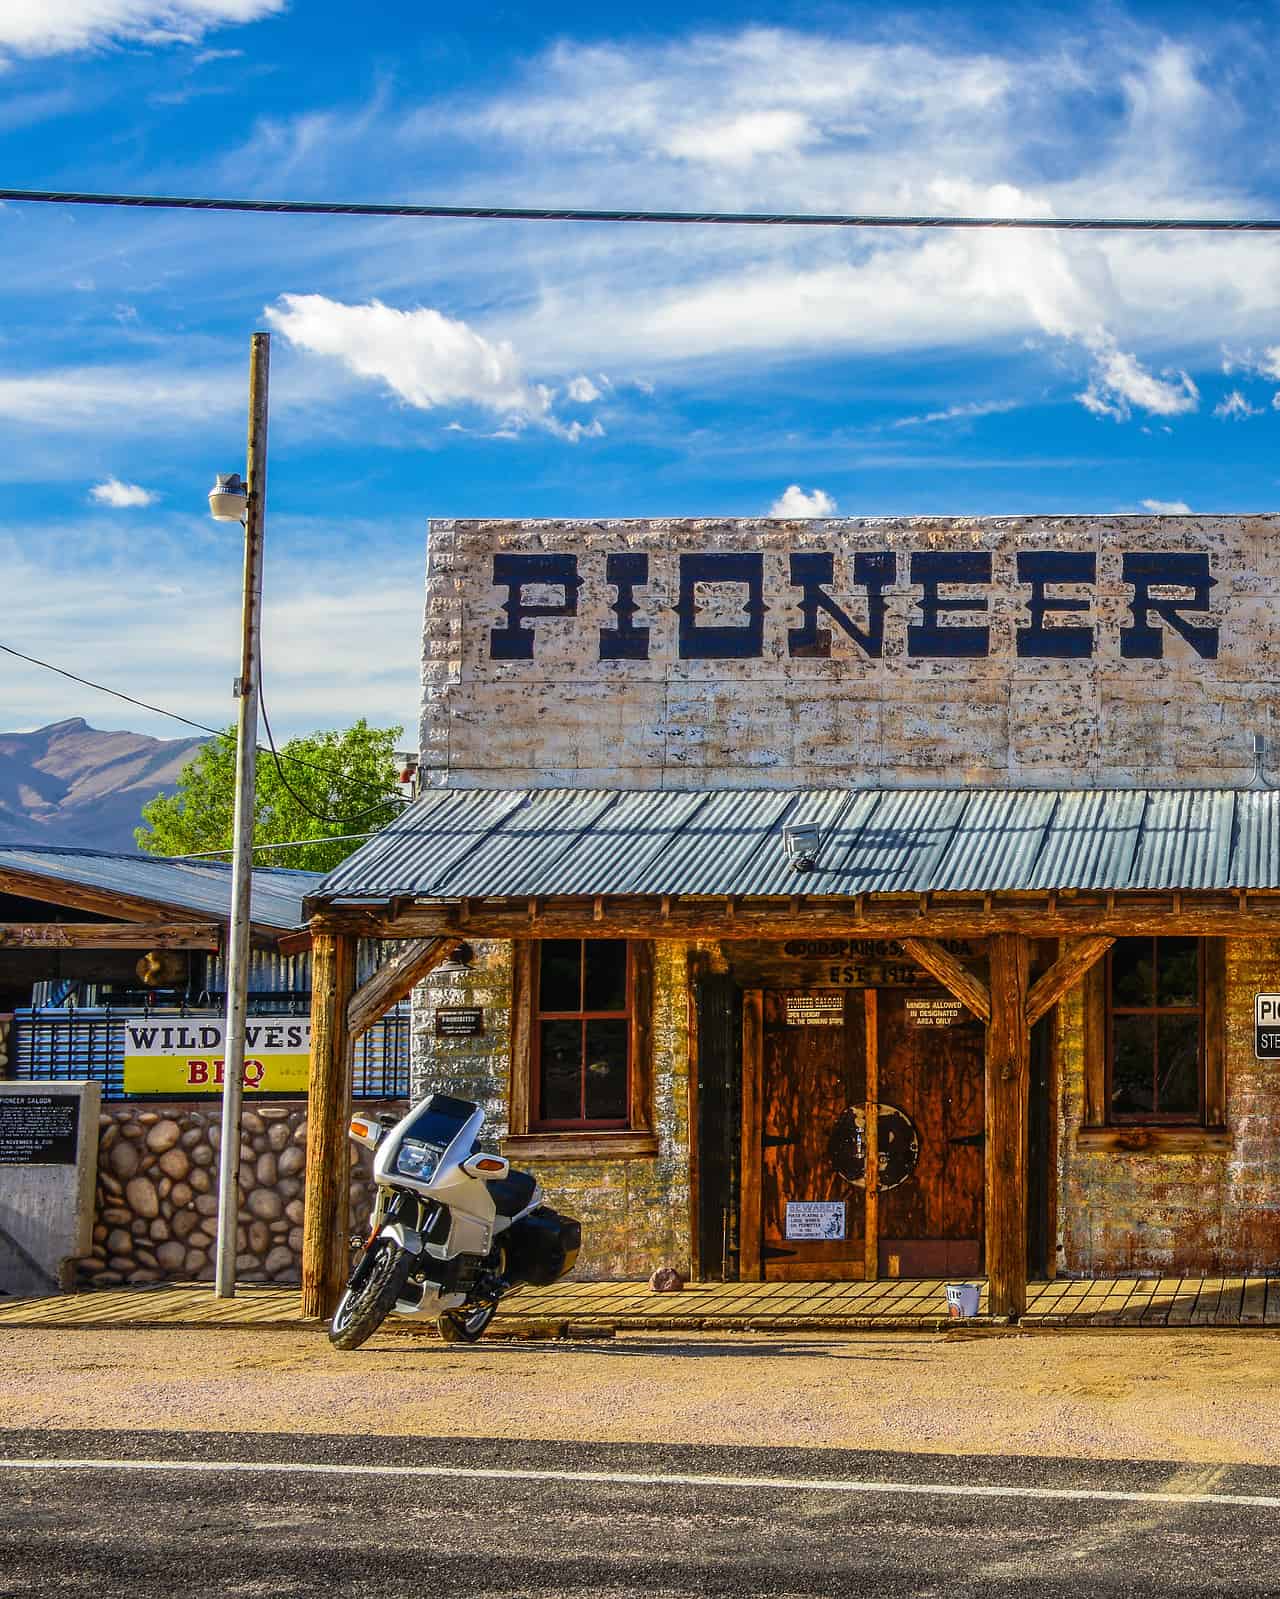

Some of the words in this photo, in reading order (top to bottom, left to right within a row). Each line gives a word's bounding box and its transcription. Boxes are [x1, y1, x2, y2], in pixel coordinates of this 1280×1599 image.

[490, 551, 1218, 660] PIONEER
[786, 997, 814, 1009] PIONEER
[815, 997, 843, 1008] SALOON
[932, 1001, 962, 1009] ALLOWED
[129, 1026, 221, 1049] WILD
[245, 1026, 312, 1048] WES
